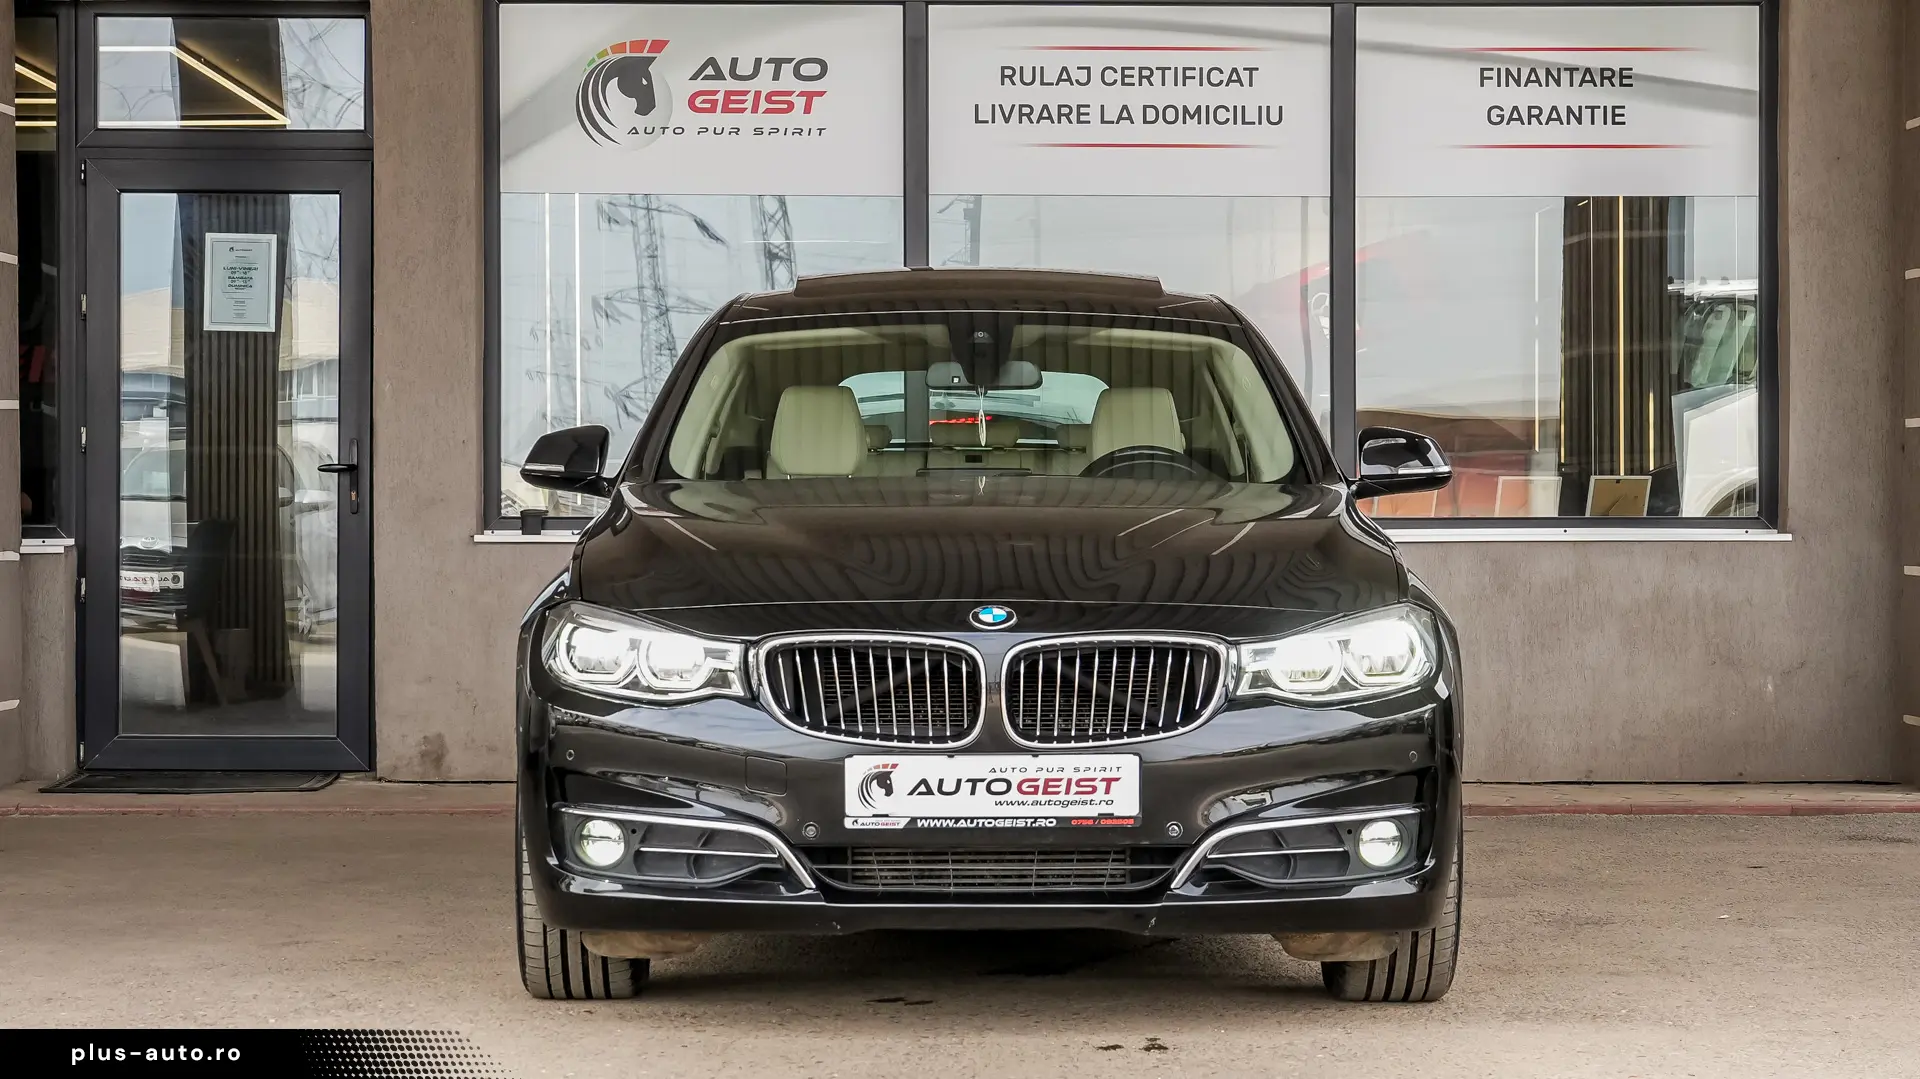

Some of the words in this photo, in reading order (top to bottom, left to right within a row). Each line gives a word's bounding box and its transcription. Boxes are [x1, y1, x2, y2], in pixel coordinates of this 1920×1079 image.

[689, 57, 829, 81] AUTO
[1000, 65, 1092, 87] RULAJ
[1100, 66, 1259, 88] CERTIFICAT
[1479, 66, 1634, 88] FINANTARE
[688, 90, 828, 115] GEIST
[974, 104, 1091, 125] LIVRARE
[1100, 104, 1135, 125] LA
[1143, 104, 1284, 126] DOMICILIU
[1486, 104, 1627, 126] GARANTIE
[626, 126, 685, 136] AUTO
[697, 126, 741, 136] PUR
[752, 127, 828, 137] SPIRIT
[994, 798, 1114, 809] www.autogeist.ro
[917, 817, 1057, 828] WWW.AUTOGEIST.RO
